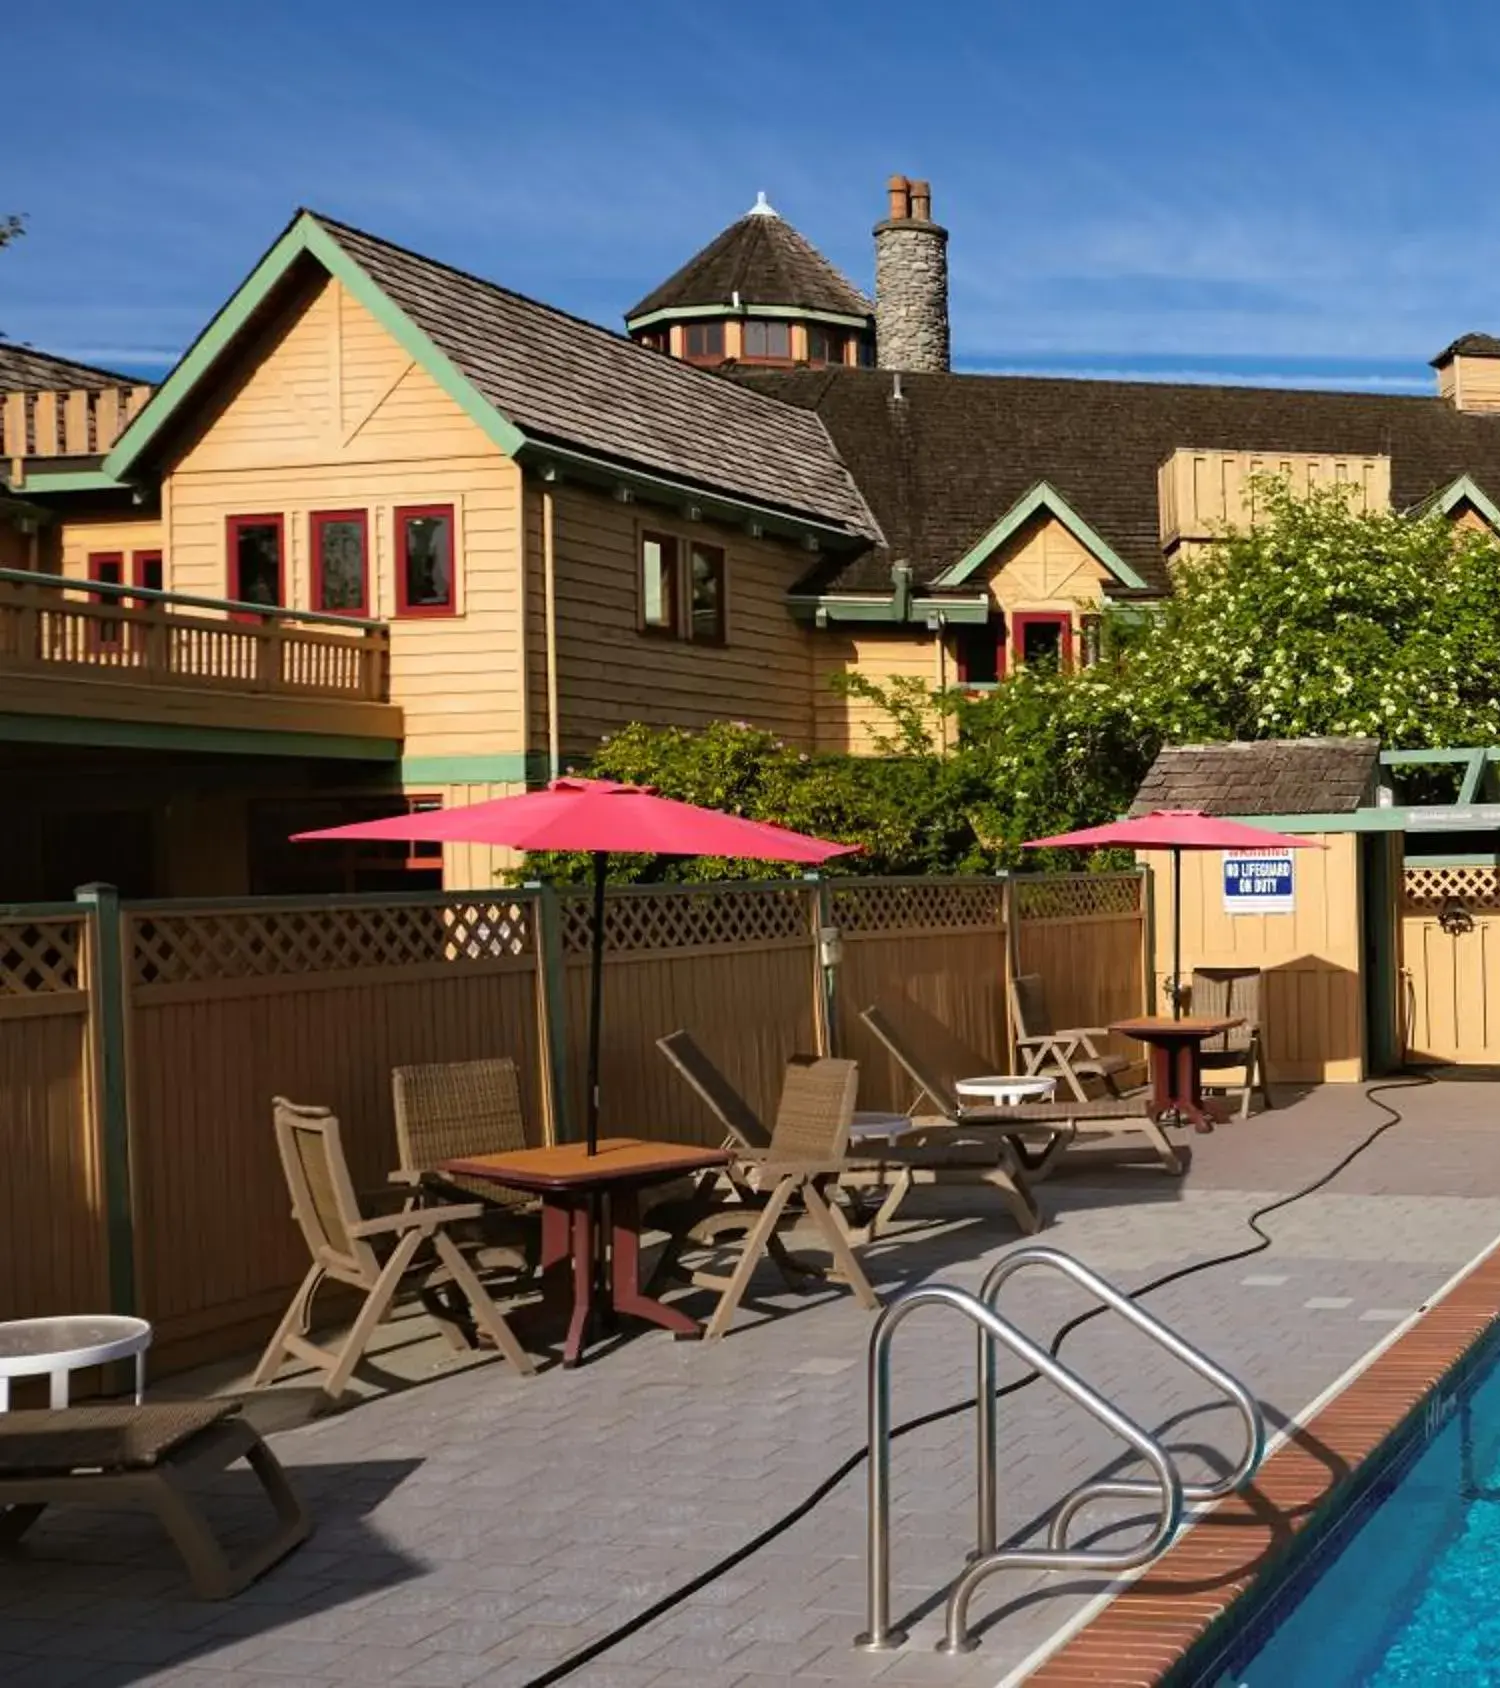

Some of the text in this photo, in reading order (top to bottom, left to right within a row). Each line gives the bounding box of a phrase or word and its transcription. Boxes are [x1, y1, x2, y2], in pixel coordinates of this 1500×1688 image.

[1226, 862, 1290, 877] NO LIFEGUARD
[1239, 879, 1277, 893] ON DUTY
